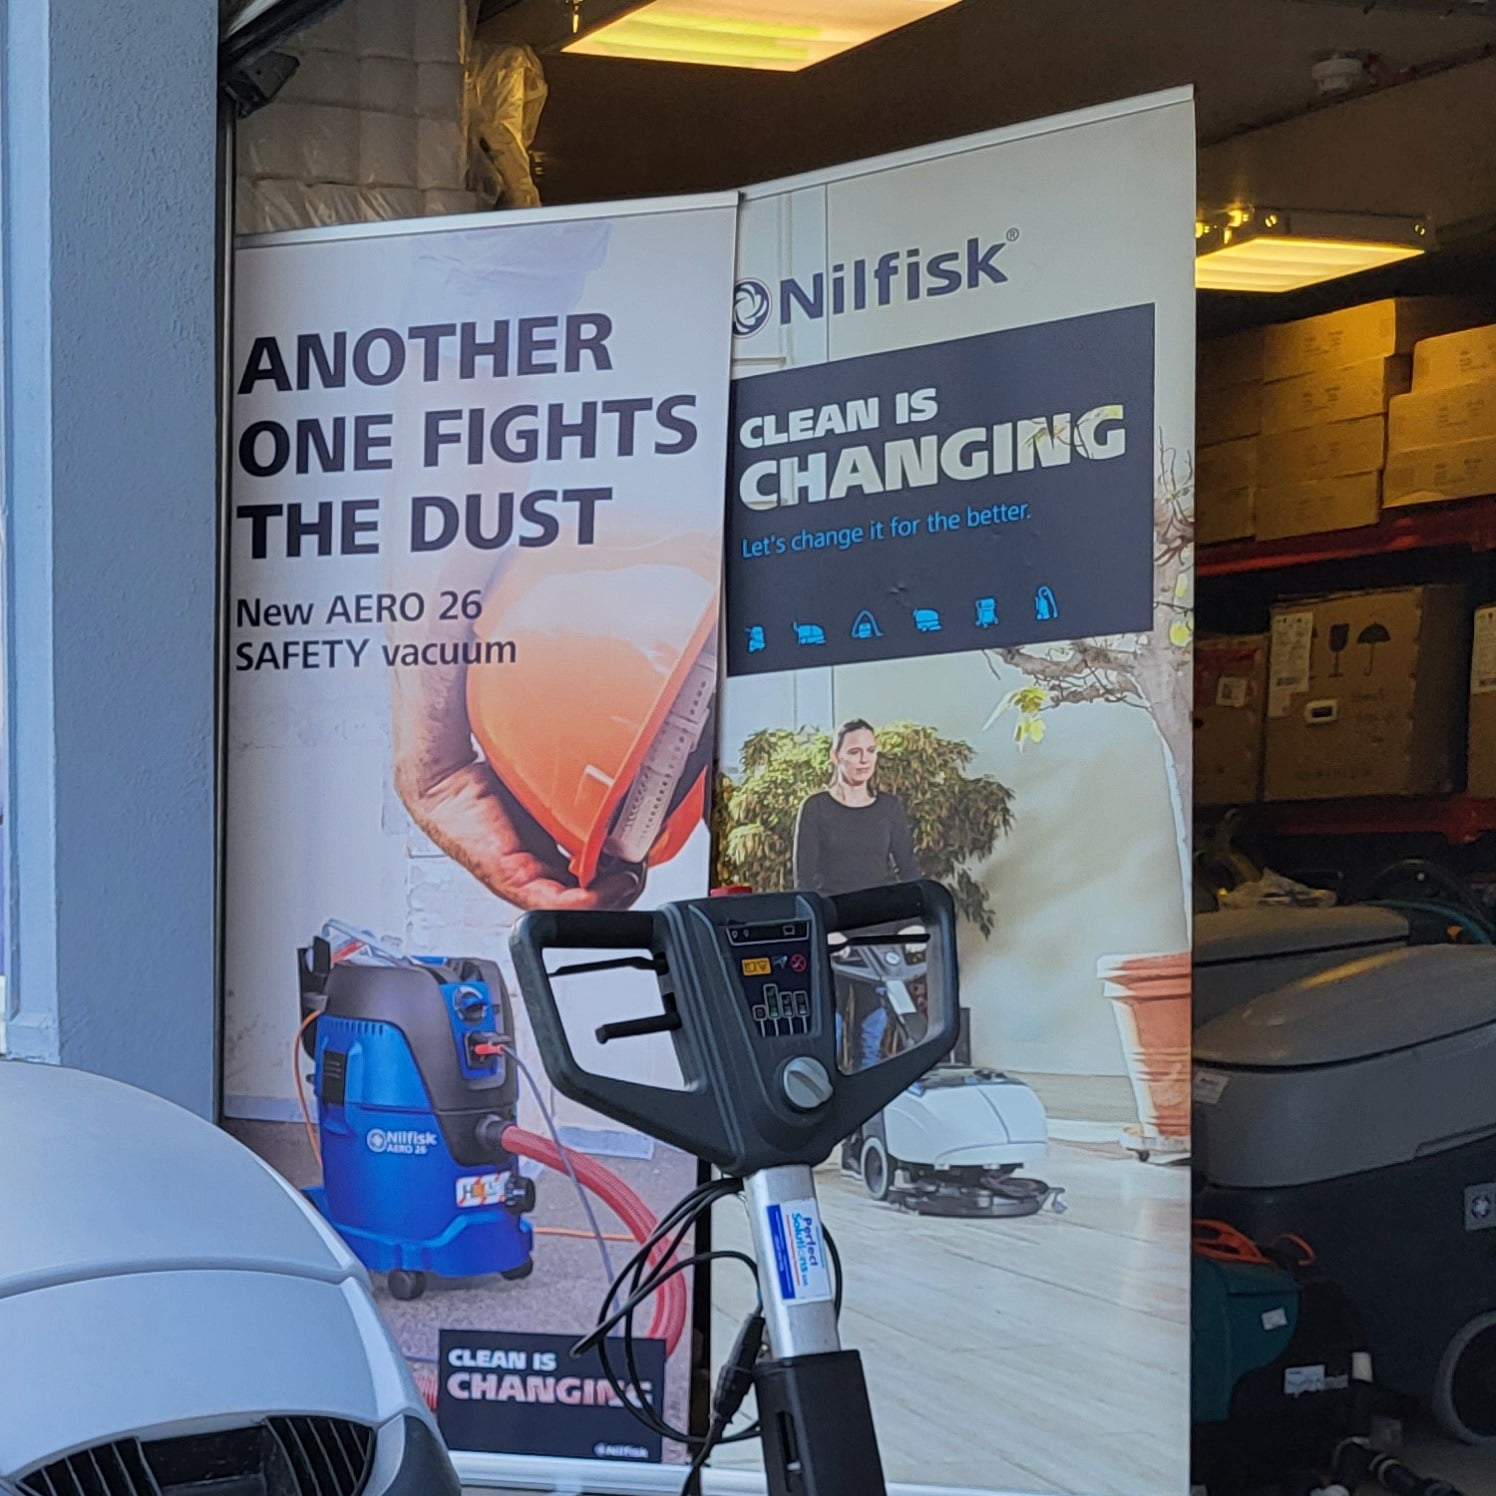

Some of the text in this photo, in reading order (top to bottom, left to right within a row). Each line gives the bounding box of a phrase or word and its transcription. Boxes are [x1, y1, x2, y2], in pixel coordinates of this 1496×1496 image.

[237, 312, 615, 395] ANOTHER
[238, 394, 700, 477] ONE FIGHTS
[739, 387, 939, 450] CLEAN IS
[738, 404, 1126, 512] CHANGING
[236, 487, 613, 560] THE DUST
[742, 502, 1032, 558] Let's change it for the better.
[236, 589, 483, 628] New AERO 26
[235, 638, 518, 672] SAFETY vacuum
[447, 1347, 558, 1371] CLEAN IS
